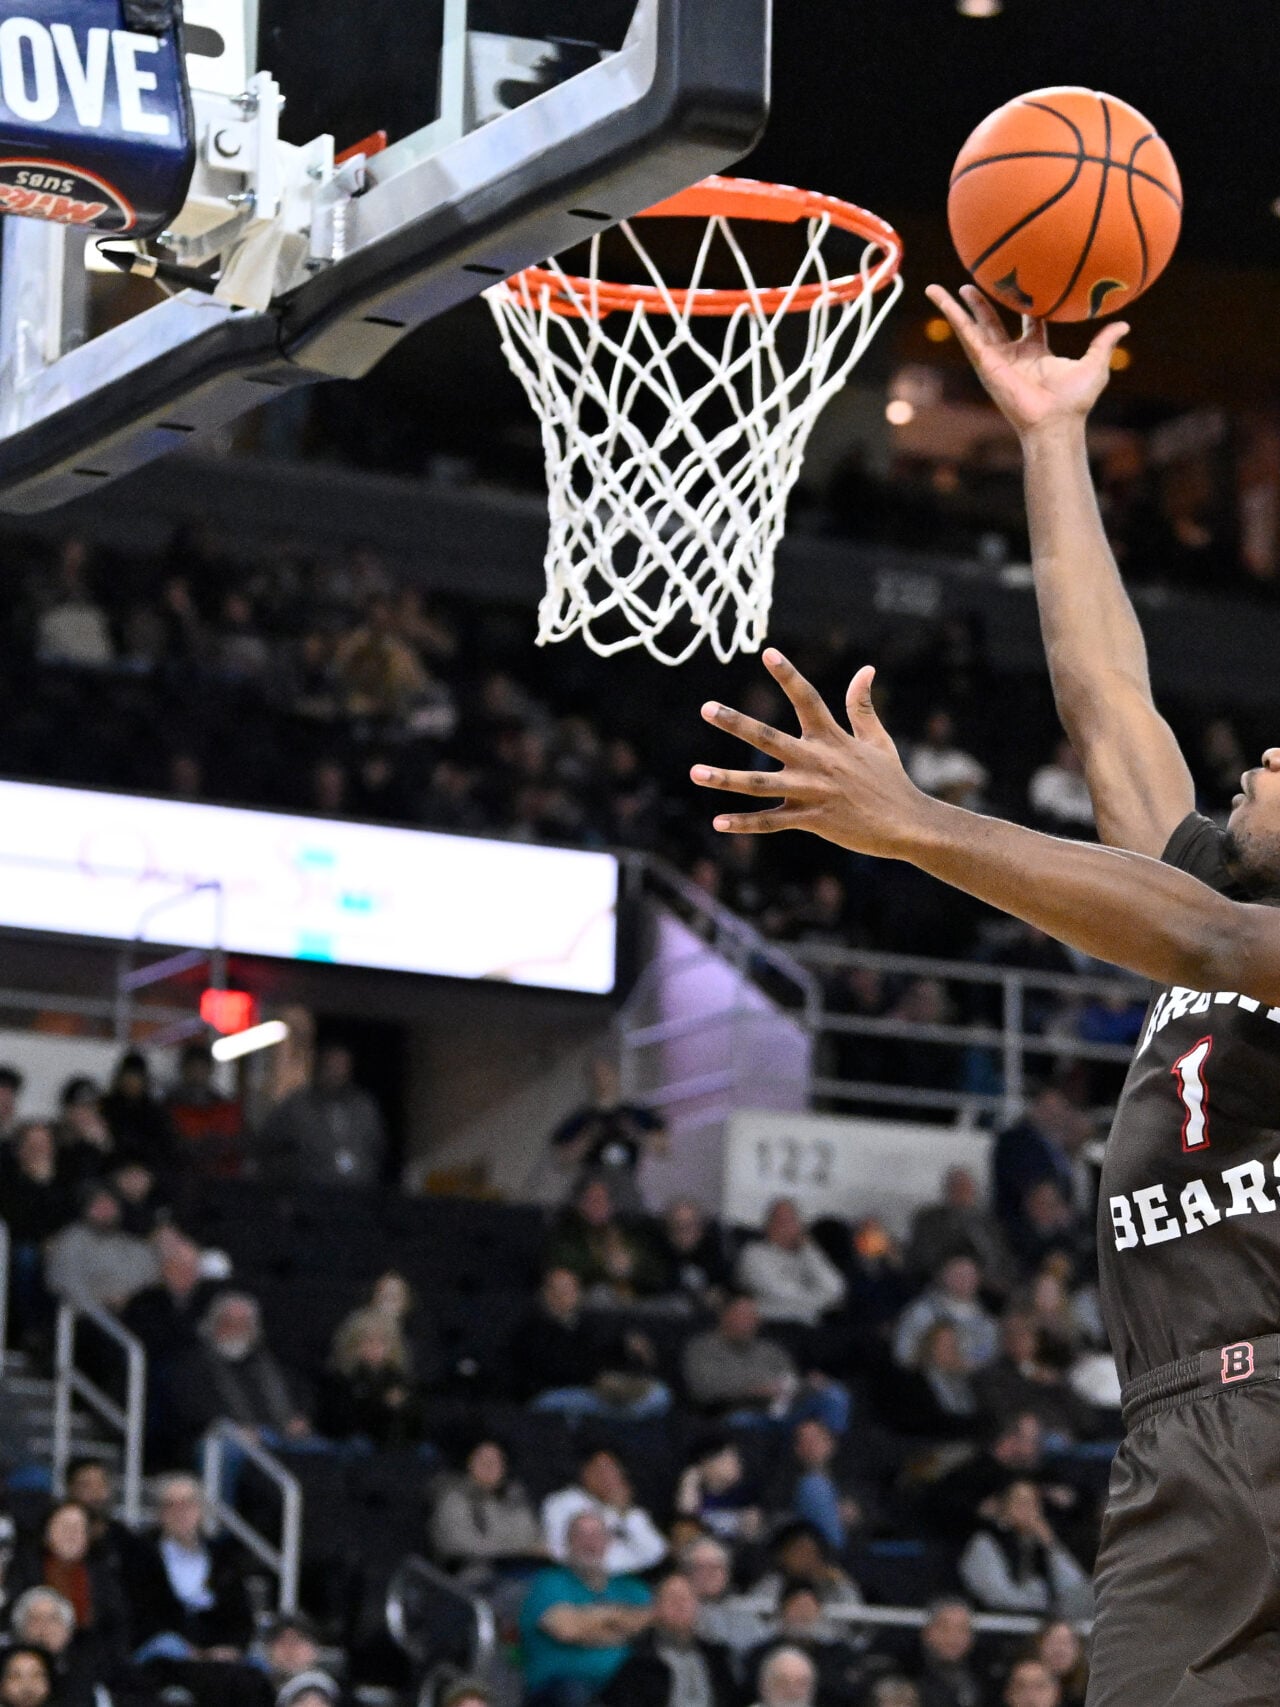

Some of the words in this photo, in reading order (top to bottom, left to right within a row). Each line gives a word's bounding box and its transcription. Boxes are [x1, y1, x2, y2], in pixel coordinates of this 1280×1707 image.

[14, 171, 75, 194] SUBS
[1171, 1035, 1212, 1152] 1
[1221, 1341, 1254, 1385] B
